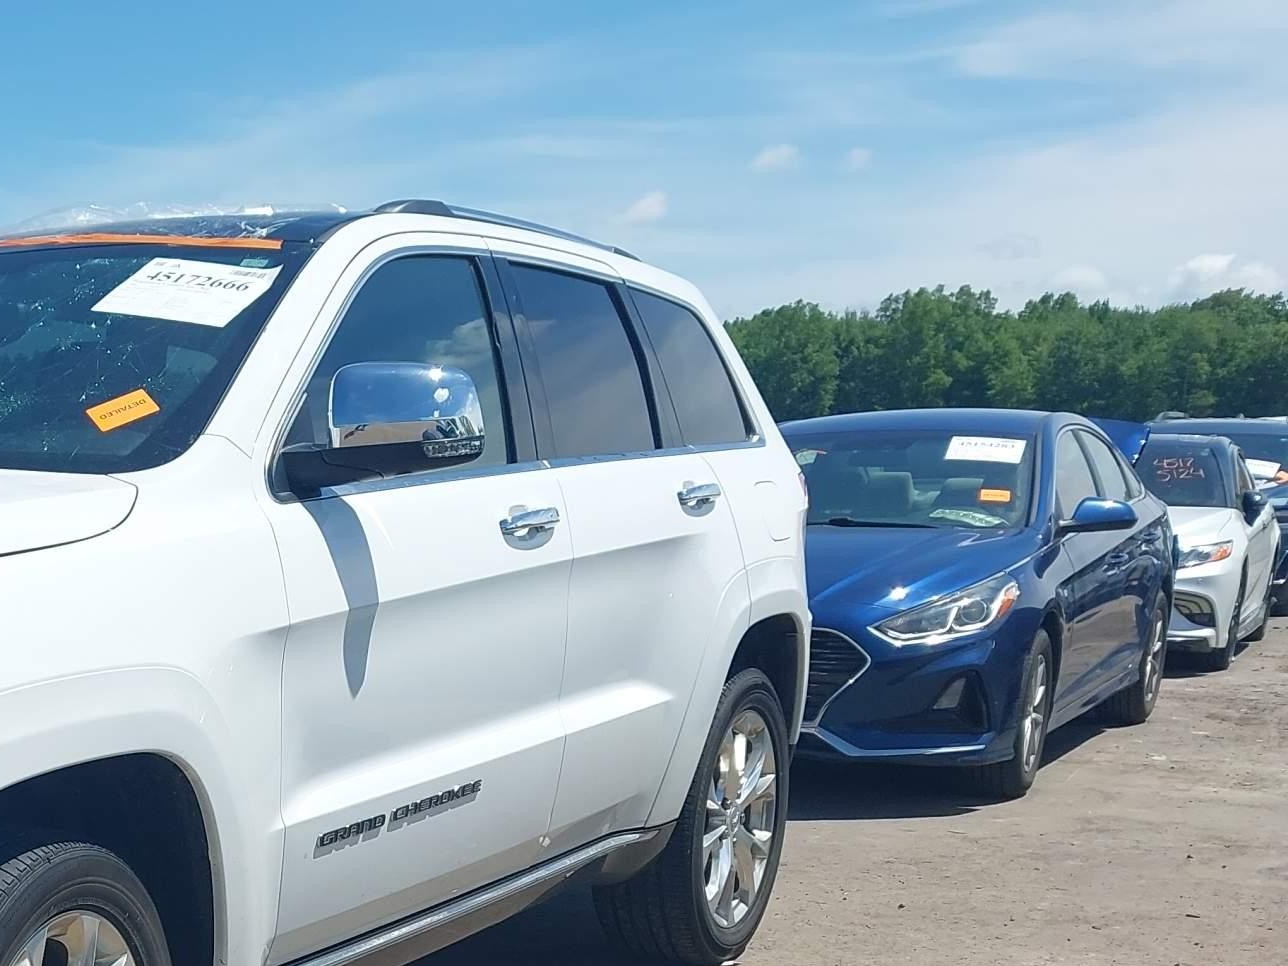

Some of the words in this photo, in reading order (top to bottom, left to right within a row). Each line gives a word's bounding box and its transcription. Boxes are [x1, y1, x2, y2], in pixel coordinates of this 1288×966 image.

[147, 270, 253, 292] 45172666
[99, 398, 147, 421] DETAILED
[1153, 457, 1194, 469] 4517
[1156, 468, 1206, 482] 5124
[318, 813, 387, 848] GRAND
[390, 779, 483, 823] CHEROKEE
